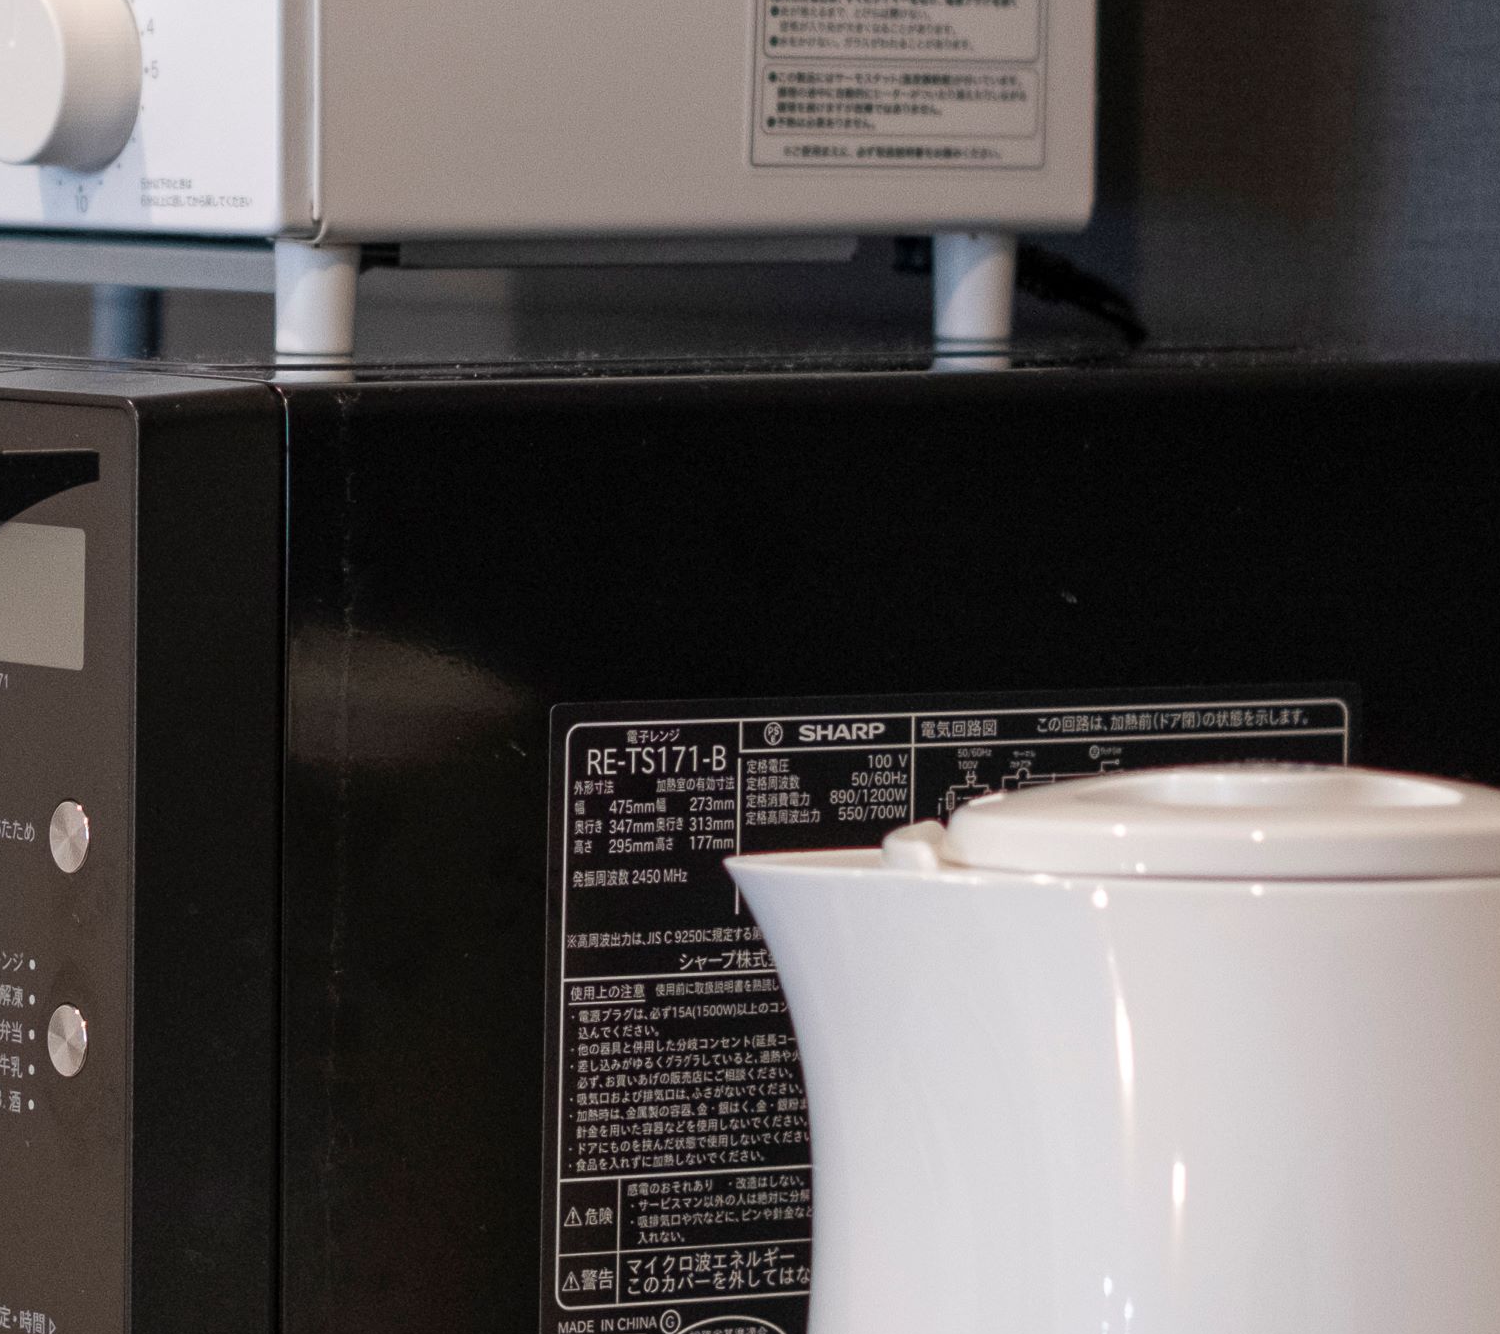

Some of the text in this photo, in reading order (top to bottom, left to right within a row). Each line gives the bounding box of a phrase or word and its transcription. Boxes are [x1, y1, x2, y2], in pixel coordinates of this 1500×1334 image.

[146, 18, 155, 34] 4
[151, 60, 159, 79] 5
[76, 195, 88, 213] 10
[626, 729, 680, 744] 電子レンジ
[798, 722, 886, 741] SHARP
[921, 719, 998, 739] 電気回路図
[587, 745, 727, 776] RE-TS171-B
[746, 754, 908, 774] 定格電圧 100 V
[573, 780, 615, 796] 外形寸法
[656, 776, 735, 793] 加熱室の有効寸法
[746, 771, 908, 791] 定格周波数 50/60Hz
[574, 799, 655, 815] 幅 475mm
[656, 797, 735, 813] 幅 273mm
[746, 788, 908, 809] 定格消費電力 890/1200W
[656, 816, 735, 832] 奥行き 313mm
[745, 805, 908, 826] 定格高周波出力 550/700W
[574, 819, 655, 835] 奥行き 347mm
[573, 838, 655, 855] 高さ 295mm
[655, 835, 734, 851] 高さ 177mm
[573, 868, 688, 888] 発振周波数 2450 MHz
[0, 984, 24, 1008] 解凍
[571, 984, 645, 1001] 使用上の注意
[578, 1026, 660, 1040] 込んでください。
[627, 1180, 714, 1197] 感電のおそれあり
[585, 1208, 614, 1226] 危険
[638, 1231, 686, 1244] 入れない。
[627, 1248, 795, 1275] マイクロ波エネルギー
[581, 1268, 614, 1291] 警告
[558, 1320, 594, 1334] MADE
[601, 1319, 614, 1332] IN
[617, 1316, 657, 1332] CHINA
